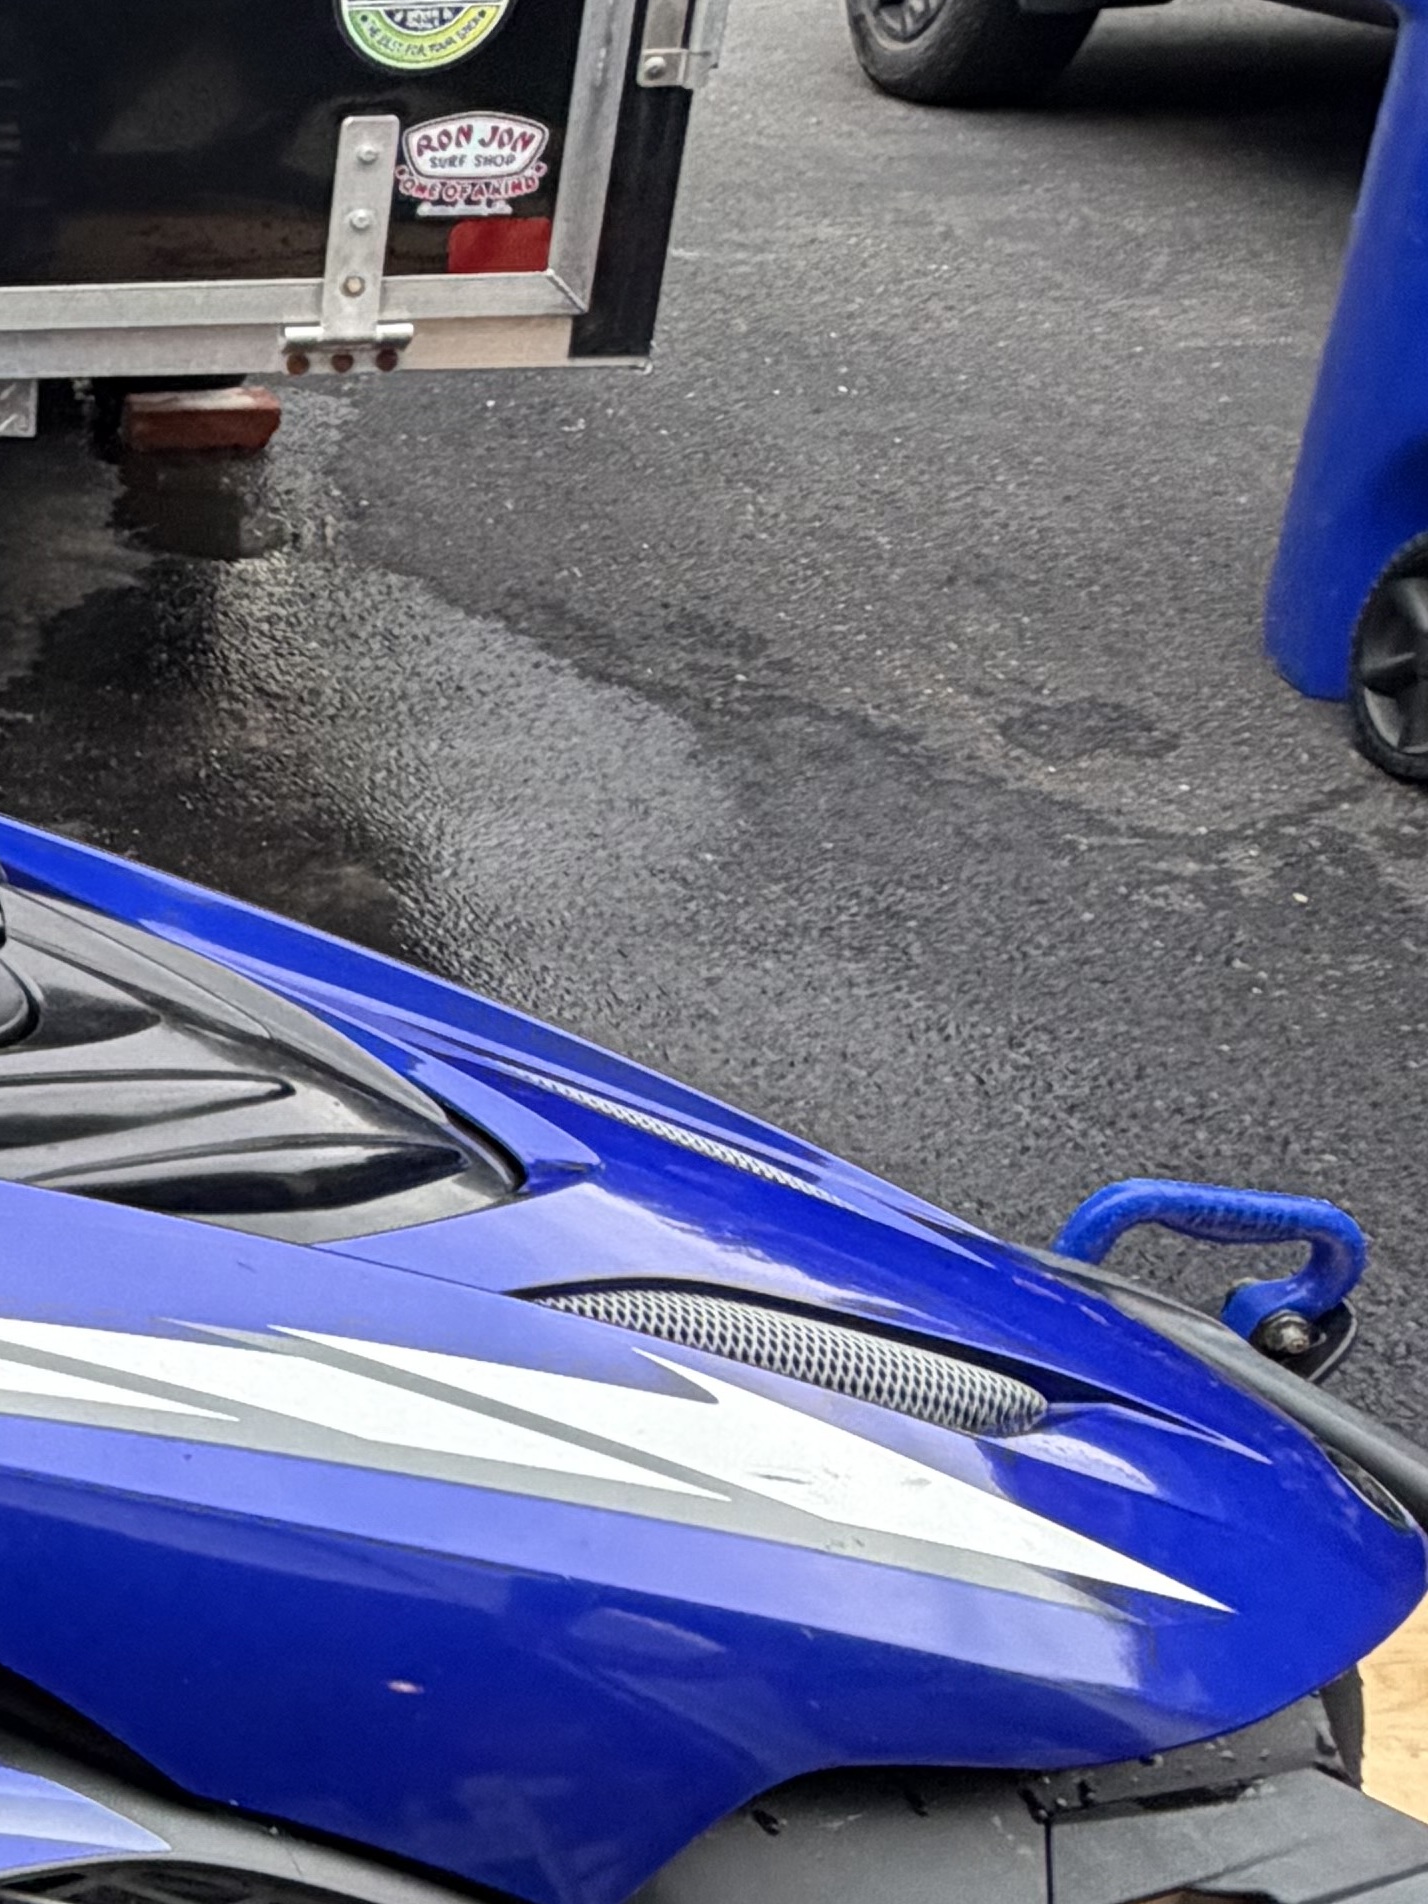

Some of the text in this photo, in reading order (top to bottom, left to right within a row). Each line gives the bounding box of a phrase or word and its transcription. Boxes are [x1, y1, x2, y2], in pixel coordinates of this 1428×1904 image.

[416, 123, 536, 157] RON JON
[429, 153, 517, 169] SURF SHOP
